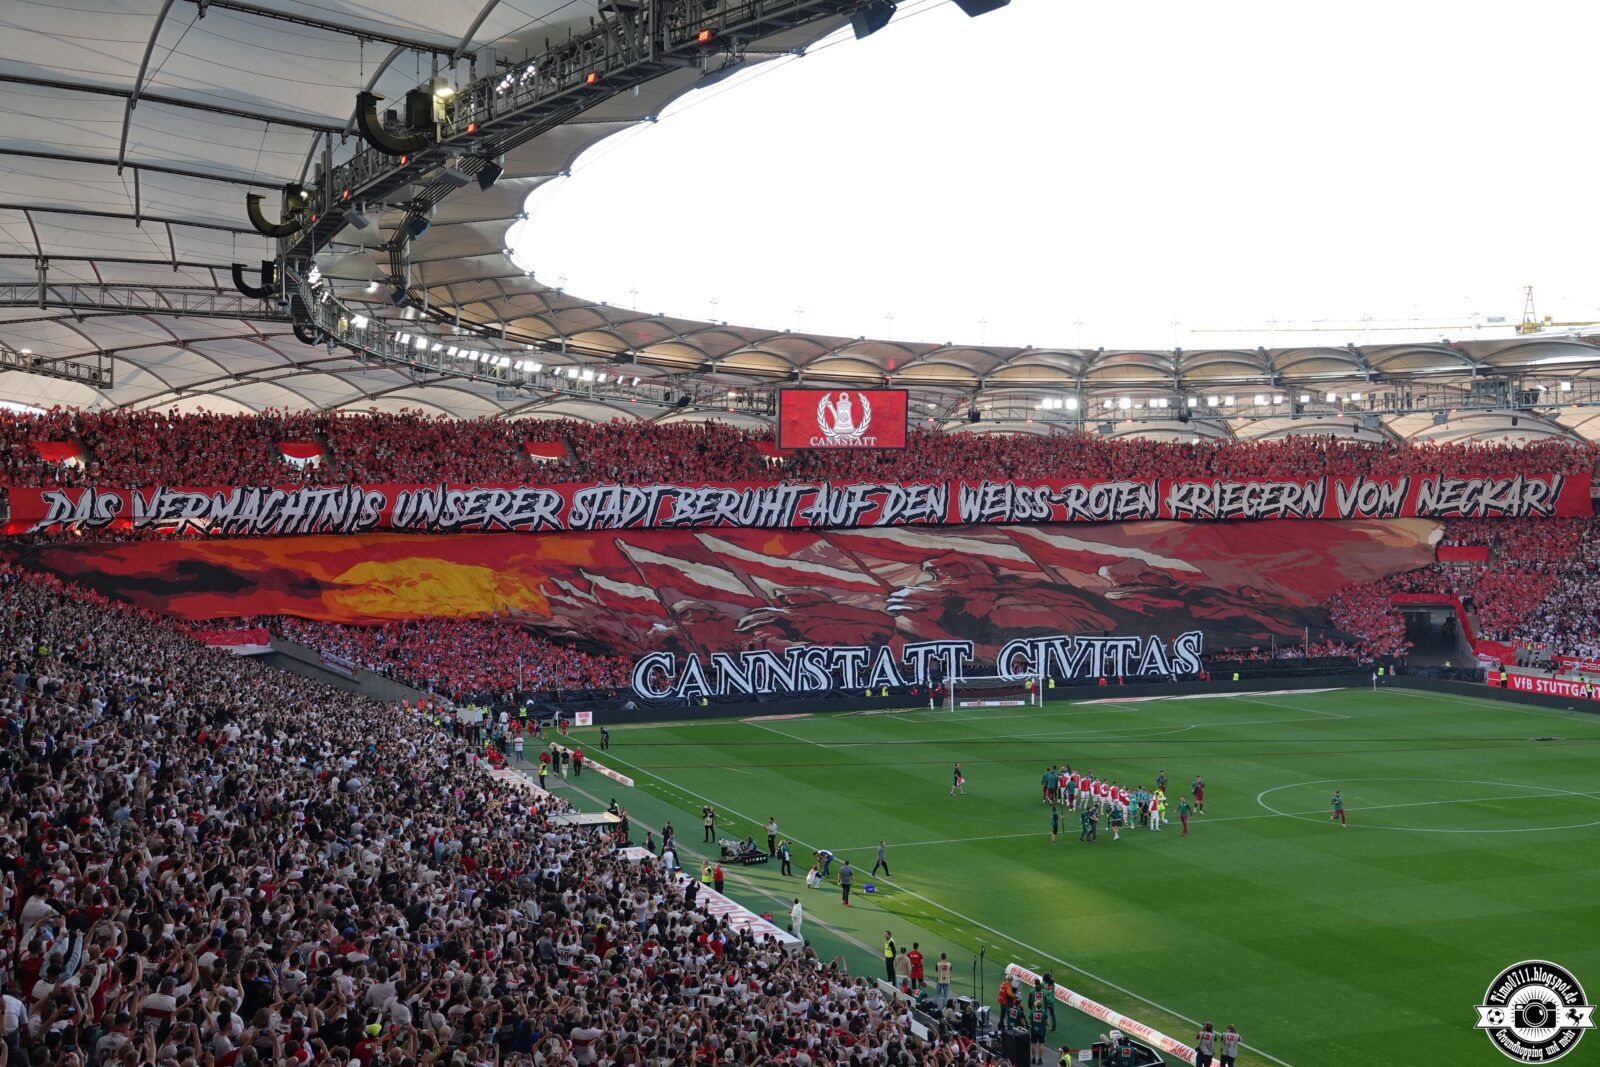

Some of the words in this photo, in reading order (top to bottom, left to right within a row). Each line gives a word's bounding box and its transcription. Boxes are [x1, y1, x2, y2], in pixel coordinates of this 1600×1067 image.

[810, 436, 877, 447] CANNSTATT
[27, 487, 123, 531] DAS
[132, 484, 387, 534] VERMÄCHTNIS
[392, 483, 564, 532] UNSERER
[568, 483, 680, 530] STADT
[659, 483, 818, 528] BERUHT
[800, 480, 895, 527] AUF
[873, 482, 949, 525] DEN
[958, 479, 1160, 523] WEISS-ROTEN
[1164, 475, 1328, 521] KRIEGERN
[1335, 475, 1411, 519] VOM
[1416, 473, 1565, 518] NECKAR!
[631, 640, 974, 699] CANNSTATT
[997, 630, 1204, 682] CIVITAS
[1513, 676, 1533, 690] VfB
